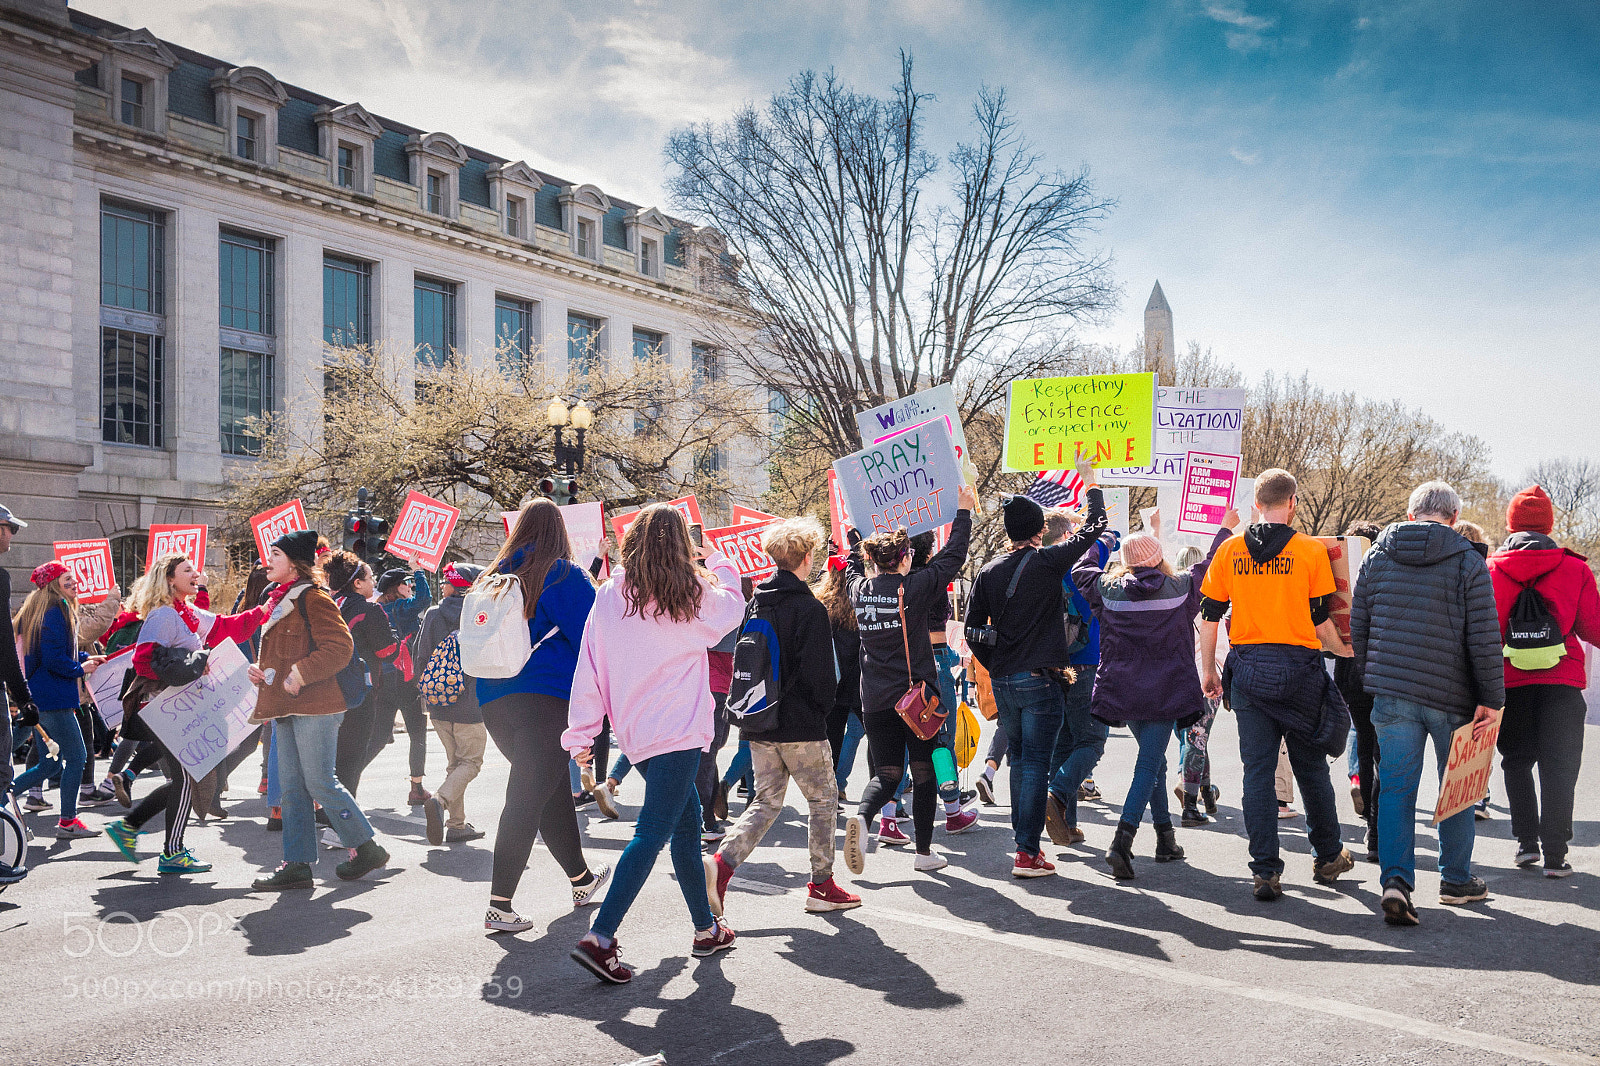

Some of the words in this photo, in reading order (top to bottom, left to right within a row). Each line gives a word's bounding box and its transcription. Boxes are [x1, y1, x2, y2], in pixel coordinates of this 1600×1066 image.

[1034, 378, 1096, 400] Respect
[1098, 379, 1124, 398] my
[1175, 390, 1206, 404] THE
[1025, 401, 1125, 423] Existence
[1158, 412, 1238, 430] LIZATION
[1028, 426, 1042, 437] or
[1048, 419, 1094, 436] expect
[1104, 420, 1128, 432] my
[1168, 431, 1200, 444] THE
[860, 433, 927, 483] PRAY,
[1191, 467, 1211, 477] ARM
[870, 468, 934, 508] mourn,
[1189, 484, 1211, 494] WITH
[1190, 476, 1231, 488] TEACHERS
[871, 488, 944, 535] REPEAT
[1185, 511, 1208, 522] GUNS
[1186, 503, 1203, 512] NOT
[400, 506, 447, 549] RISE
[725, 533, 777, 573] RIS
[66, 555, 105, 594] RISE
[1233, 557, 1263, 575] YOU'RE
[1267, 557, 1294, 575] FIRED!
[884, 620, 901, 629] B.S.
[231, 685, 242, 694] is
[212, 698, 226, 712] on
[181, 711, 208, 736] your
